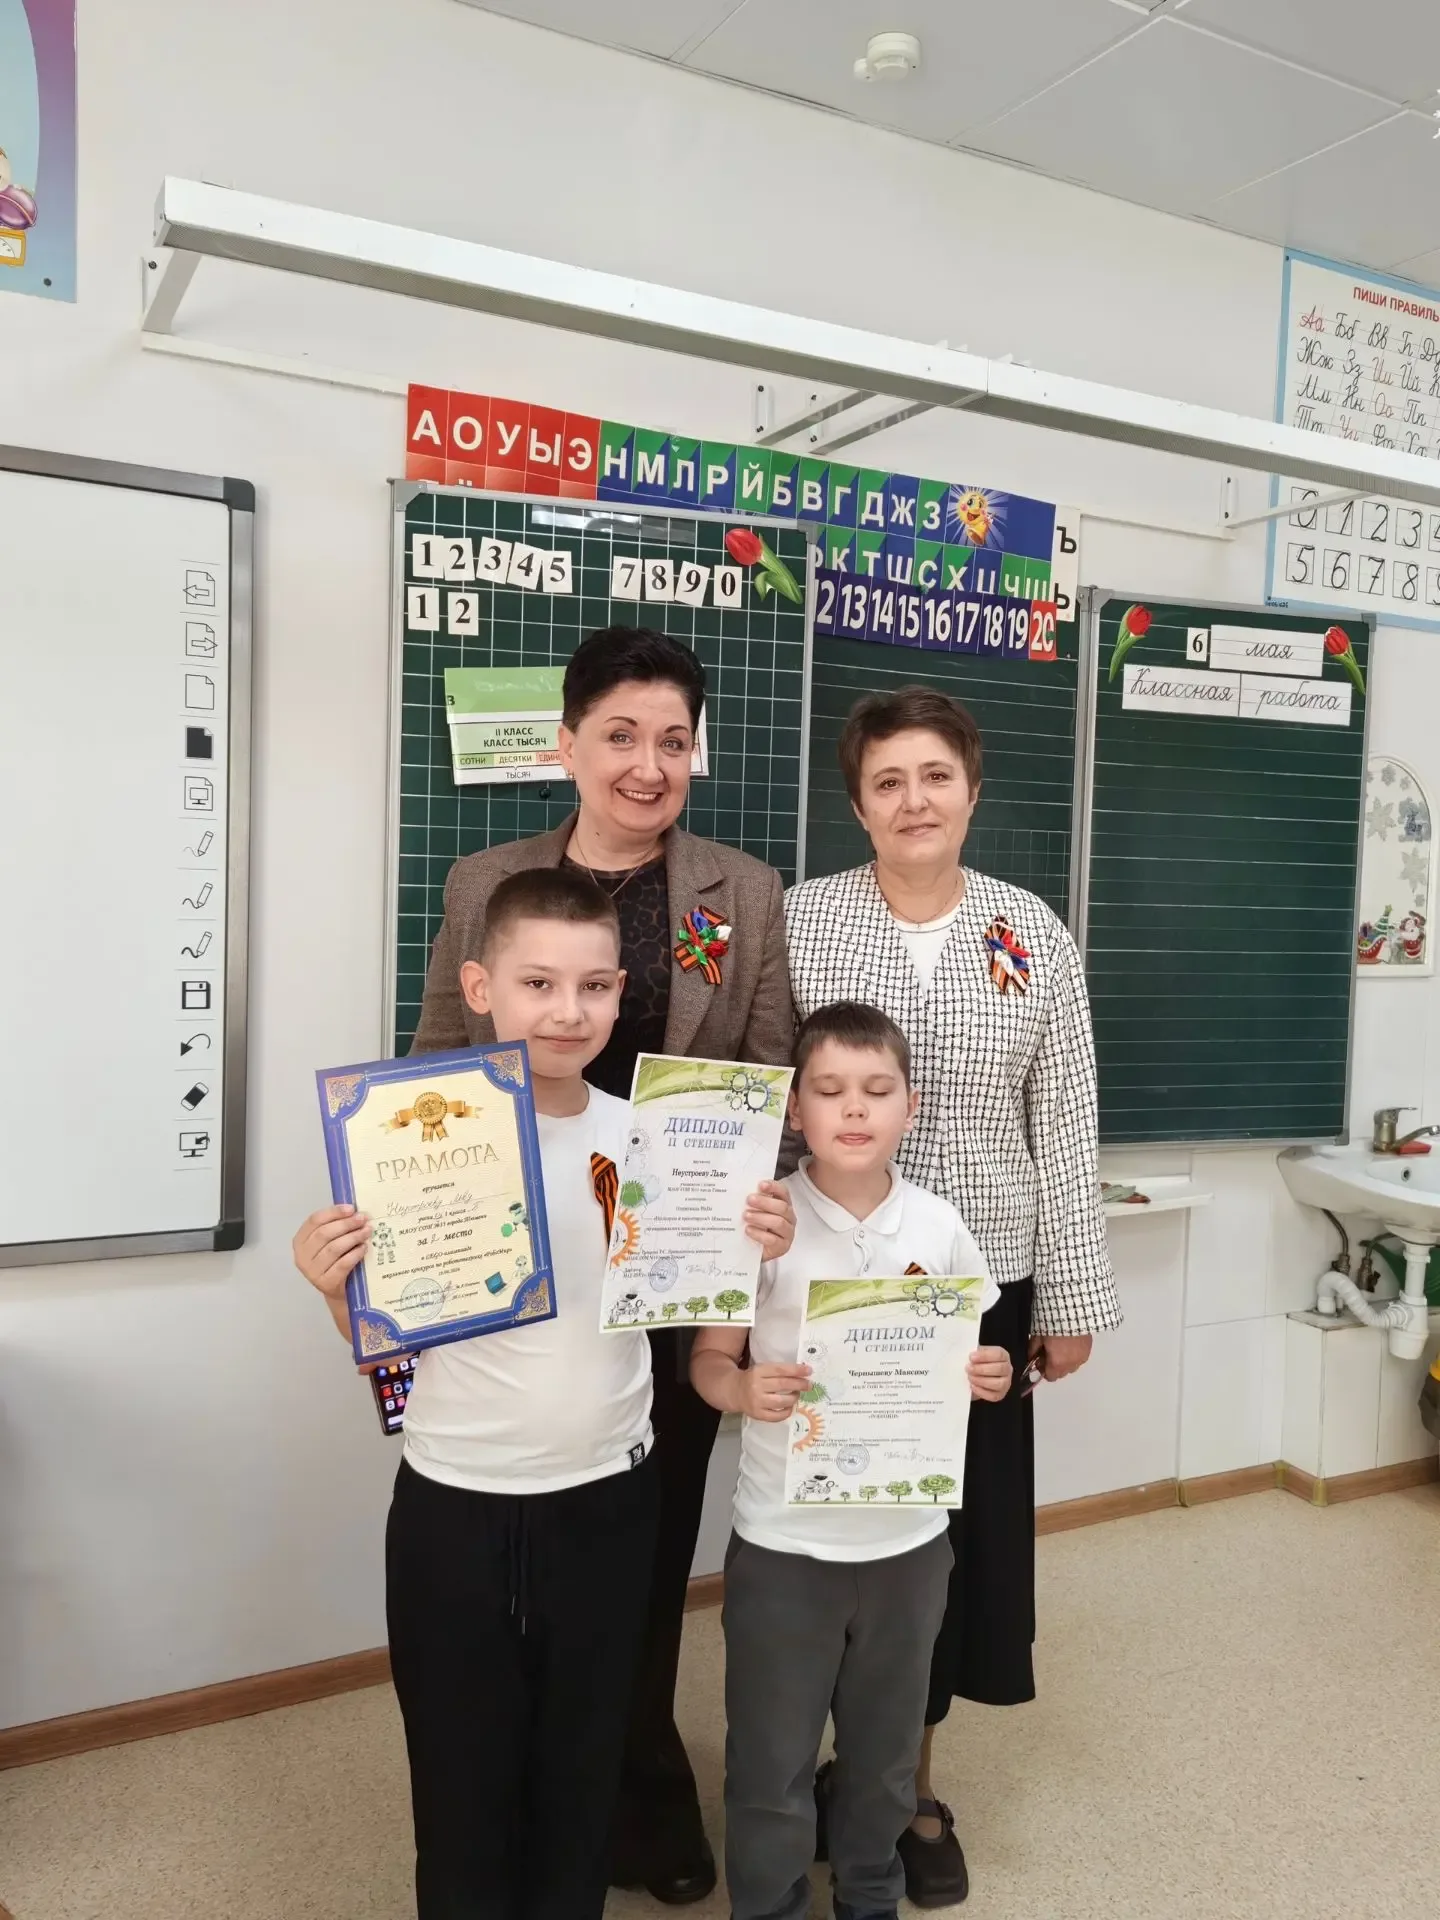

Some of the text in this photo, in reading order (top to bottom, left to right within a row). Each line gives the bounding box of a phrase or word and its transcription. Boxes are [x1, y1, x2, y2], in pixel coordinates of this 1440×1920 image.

[1353, 286, 1387, 309] ПИШИ
[1299, 305, 1325, 333] Аа
[1335, 312, 1361, 340] Бб
[1367, 322, 1389, 350] Вв
[1297, 336, 1334, 370] Жж
[1297, 373, 1427, 426] Мм Нн Оо Пп
[1342, 500, 1354, 535] 1
[1371, 503, 1391, 542] 2
[1402, 510, 1423, 548] 3
[1056, 525, 1077, 554] Ъ
[421, 540, 736, 597] 1 2 3 4 5 7 8 9 0
[1291, 545, 1315, 583] 5
[1331, 551, 1351, 589] 6
[1368, 556, 1386, 594] 7
[1402, 563, 1419, 600] 8
[841, 584, 867, 629] 13
[872, 589, 894, 634] 14
[898, 594, 920, 638] 15
[924, 598, 951, 642] 16
[955, 601, 980, 644] 17
[983, 604, 1004, 648] 18
[1008, 608, 1029, 650] 19
[1192, 633, 1203, 653] 6
[1245, 642, 1294, 659] мая
[1130, 667, 1343, 716] Классная работа
[503, 727, 534, 736] КЛАСС
[483, 736, 548, 748] КЛАСС ТЫСЯЧ
[460, 757, 487, 766] СОТНИ
[499, 755, 533, 765] ДЕСЯТКИ
[664, 1116, 746, 1136] ДИПЛОМ
[683, 1138, 736, 1150] СТЕПЕНИ
[375, 1142, 500, 1183] ГРАМОТА
[710, 1169, 729, 1179] Льву
[417, 1238, 428, 1247] за
[443, 1228, 473, 1242] место
[844, 1325, 936, 1344] ДИПЛОМ
[865, 1342, 925, 1353] СТЕПЕНИ
[847, 1368, 929, 1378] Чернышеву Максиму
